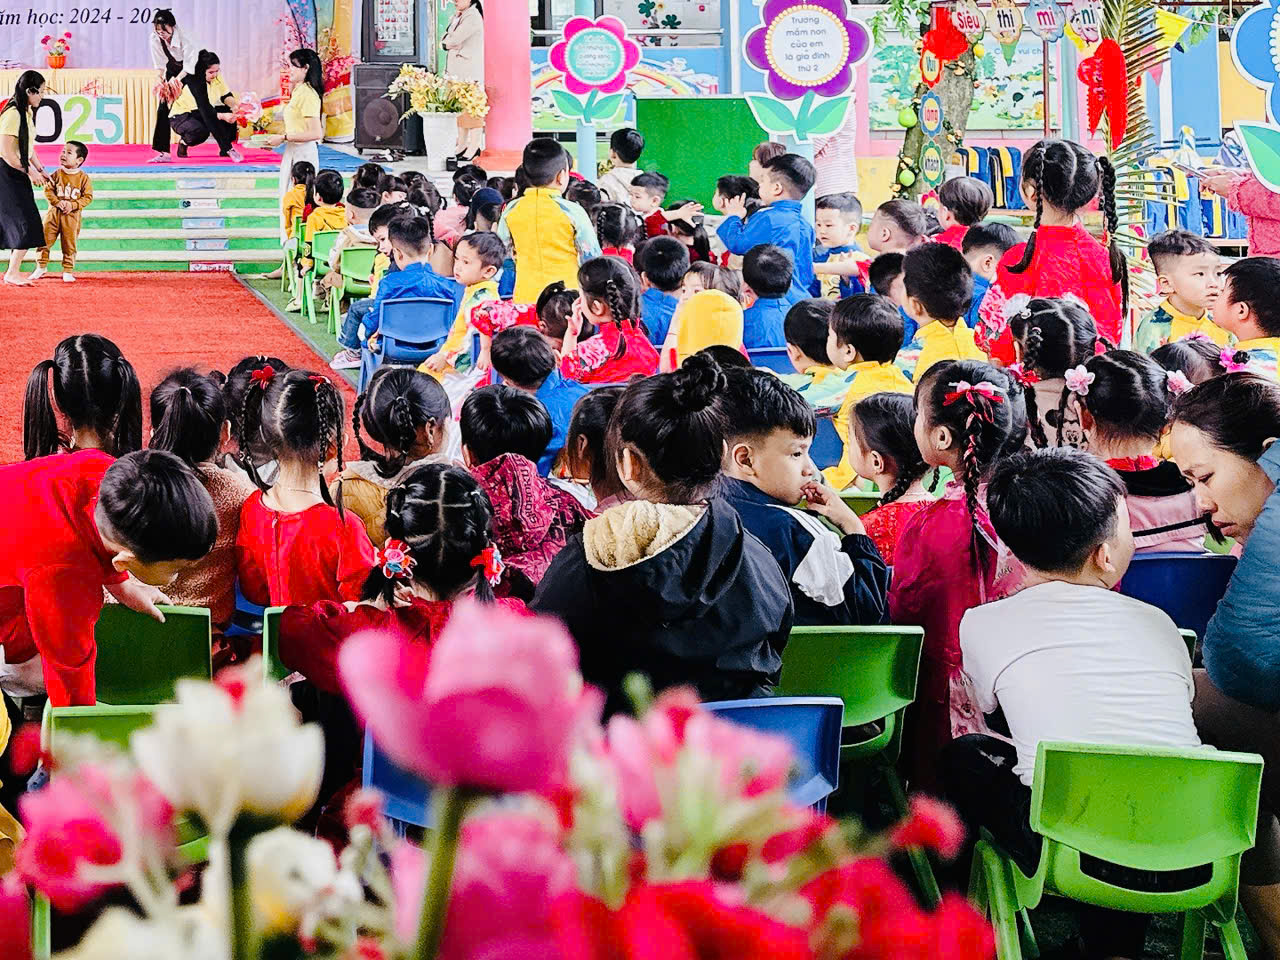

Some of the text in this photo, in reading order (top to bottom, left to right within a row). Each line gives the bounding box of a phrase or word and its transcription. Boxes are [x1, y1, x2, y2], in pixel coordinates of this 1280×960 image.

[27, 8, 64, 28] học:
[69, 7, 112, 24] 2024
[129, 7, 172, 24] 202
[958, 10, 980, 30] Siêu
[996, 9, 1015, 33] thị
[1036, 6, 1056, 25] mi
[1081, 4, 1096, 25] ni
